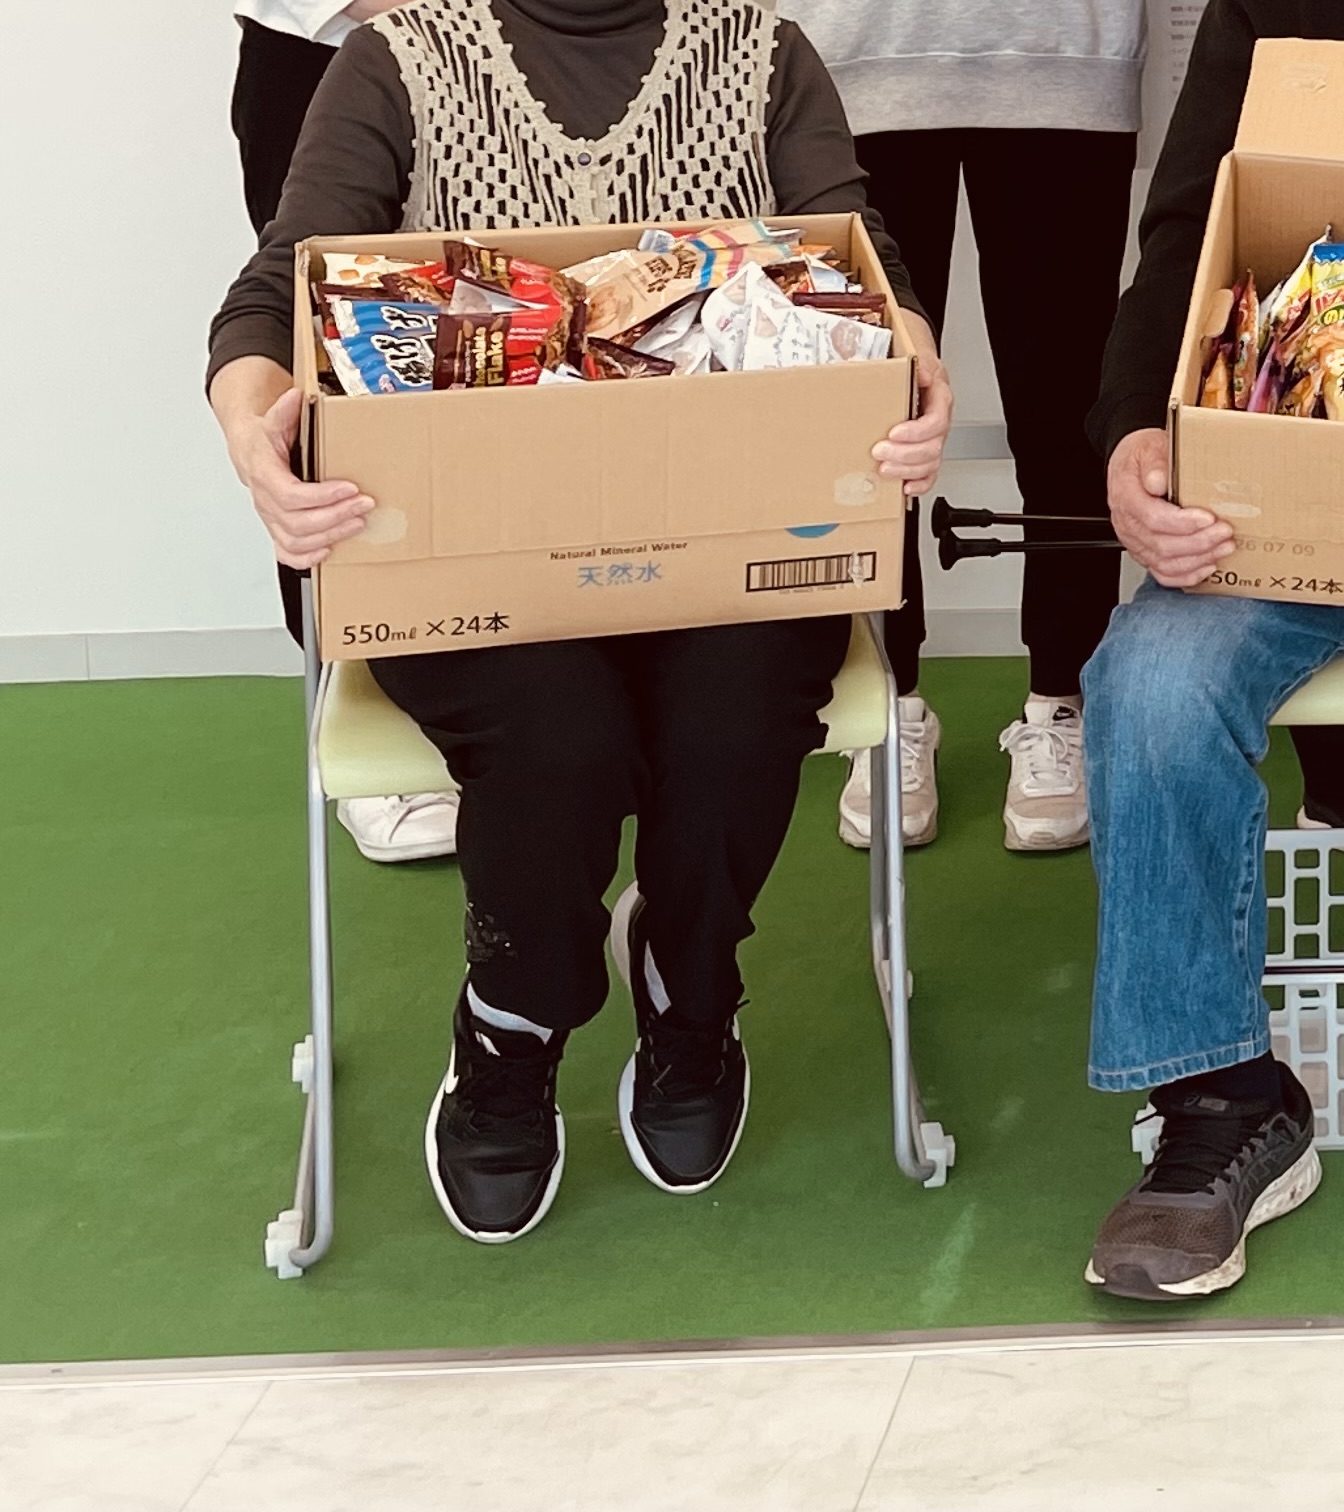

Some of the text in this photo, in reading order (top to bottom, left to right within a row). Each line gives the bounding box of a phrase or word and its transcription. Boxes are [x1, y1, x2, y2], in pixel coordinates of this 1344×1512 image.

[550, 541, 688, 561] Natural Mineral Water
[1263, 541, 1285, 554] 07
[1292, 544, 1315, 557] 09
[577, 559, 662, 587] 天然水
